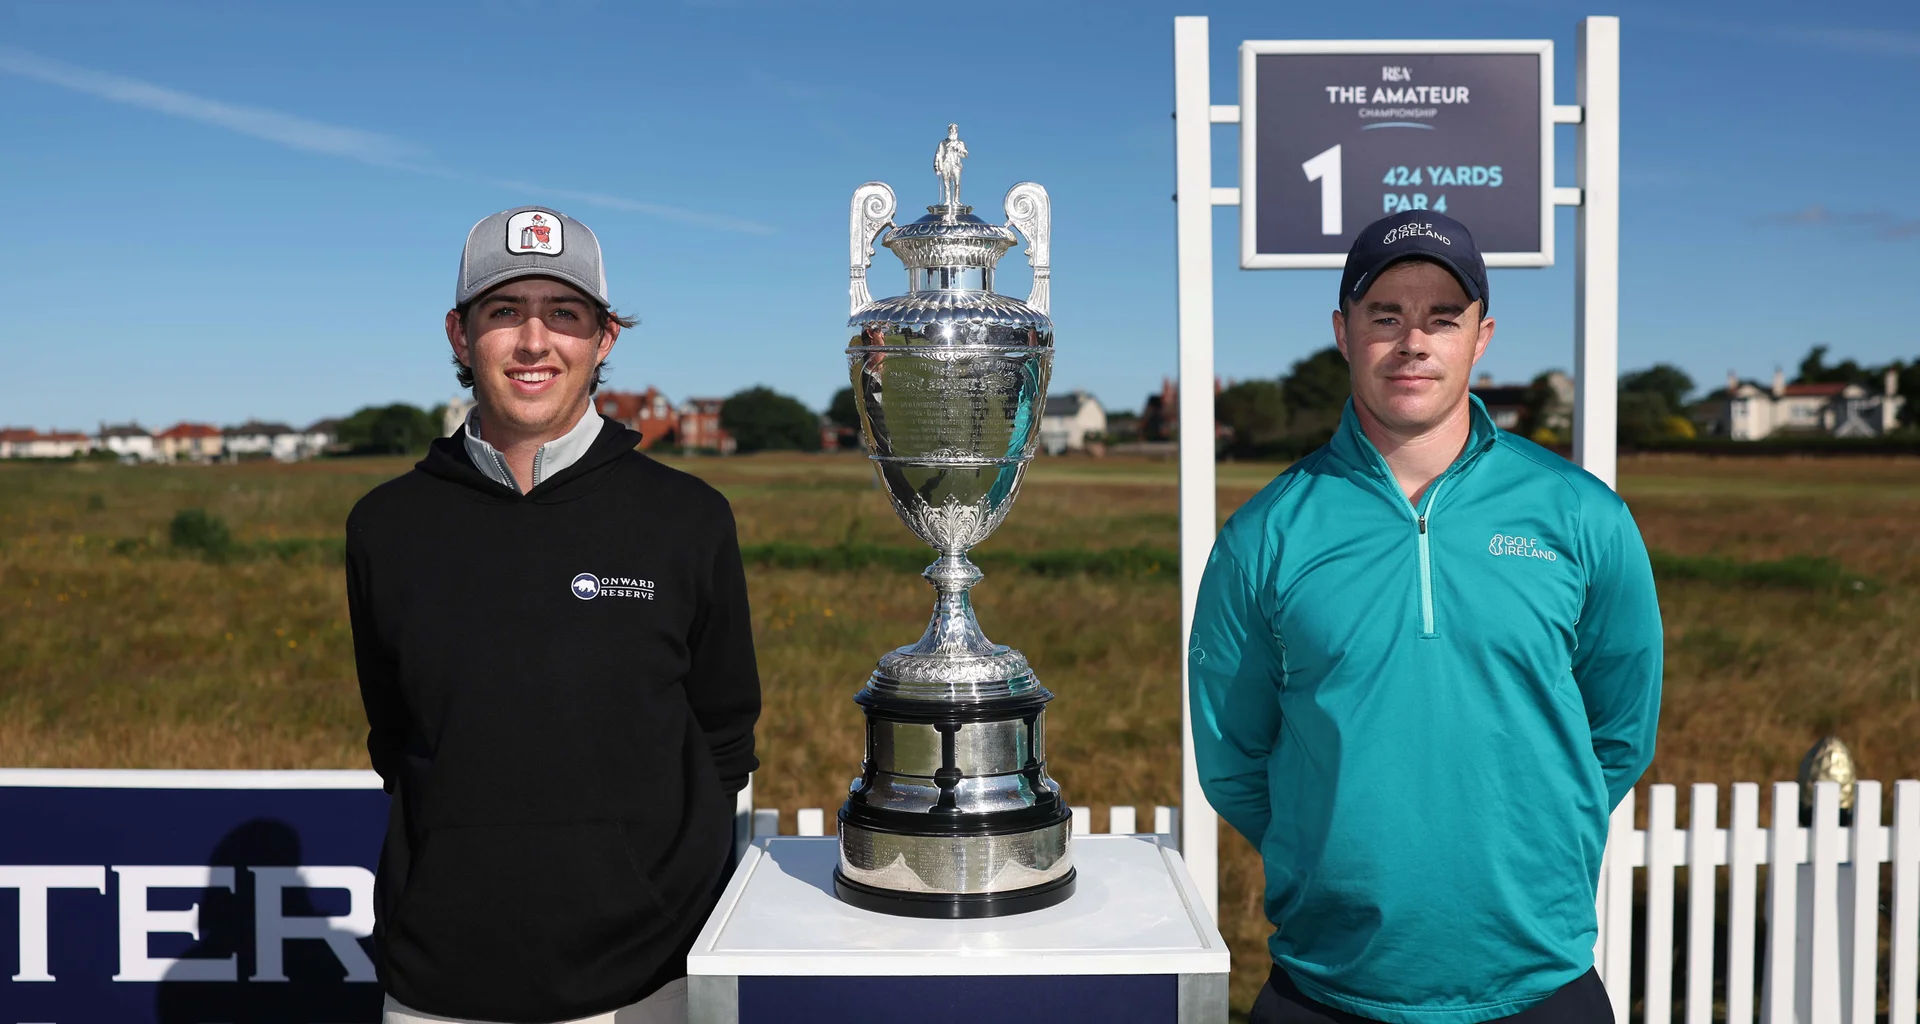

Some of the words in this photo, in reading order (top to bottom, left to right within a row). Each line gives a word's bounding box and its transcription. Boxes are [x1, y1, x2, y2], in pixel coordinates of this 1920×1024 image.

[1326, 86, 1367, 104] THE
[1371, 86, 1470, 104] AMATEUR
[1358, 107, 1438, 118] CHAMPIONSHIP
[1382, 165, 1423, 187] 424
[1426, 165, 1503, 187] YARDS
[1302, 143, 1342, 235] 1
[1383, 192, 1428, 214] PAR
[1432, 193, 1448, 214] 4
[1398, 222, 1433, 233] GOLF
[1398, 228, 1451, 246] IRELAND
[1504, 535, 1537, 548] GOLF
[1504, 546, 1556, 561] IRELAND
[601, 577, 654, 588] ONWARD
[600, 589, 654, 600] RESERVE
